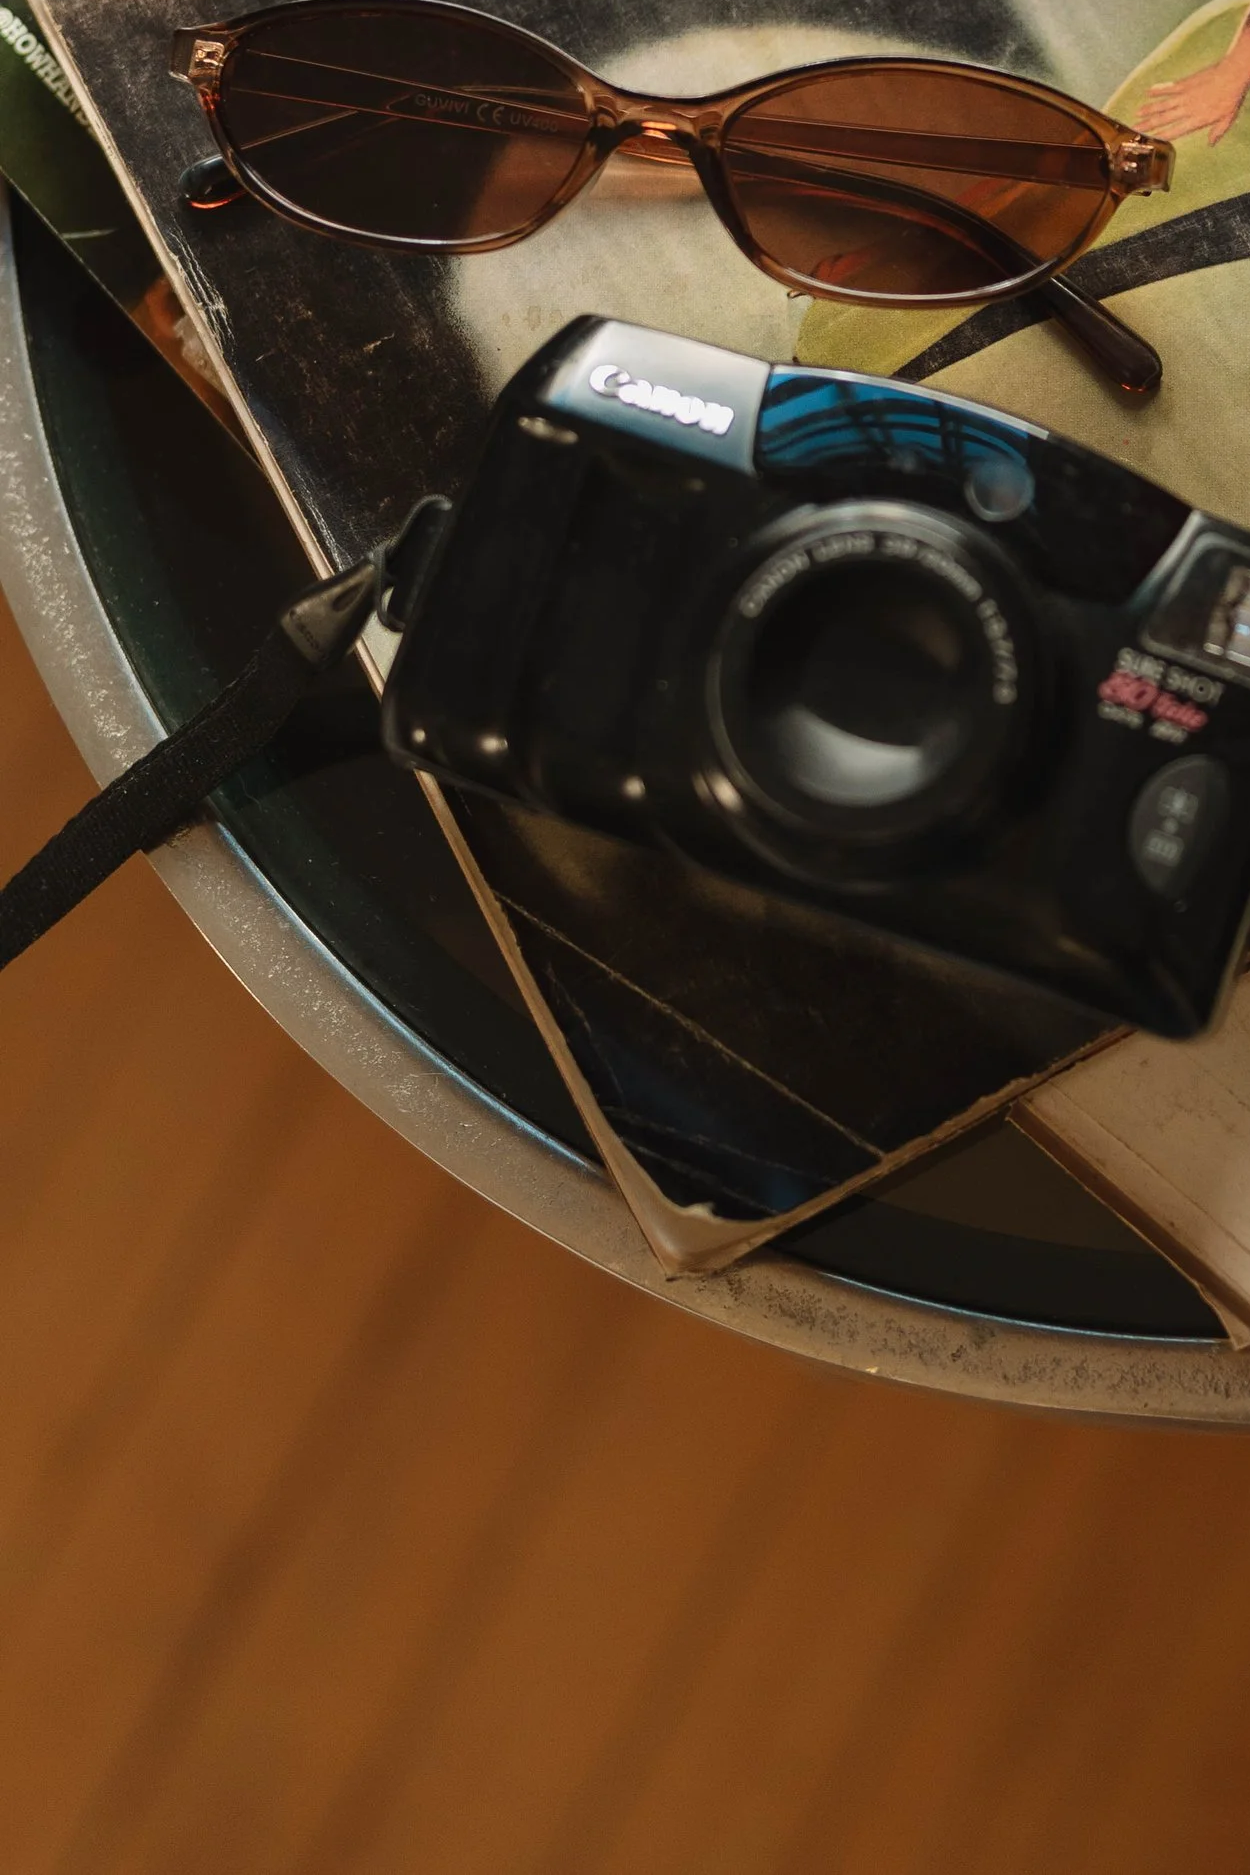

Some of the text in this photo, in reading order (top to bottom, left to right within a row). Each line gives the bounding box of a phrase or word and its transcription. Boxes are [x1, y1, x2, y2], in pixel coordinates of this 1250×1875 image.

[509, 111, 559, 133] UV400
[588, 364, 735, 436] Canon
[739, 549, 811, 618] CANON
[1167, 665, 1223, 706] SHOT
